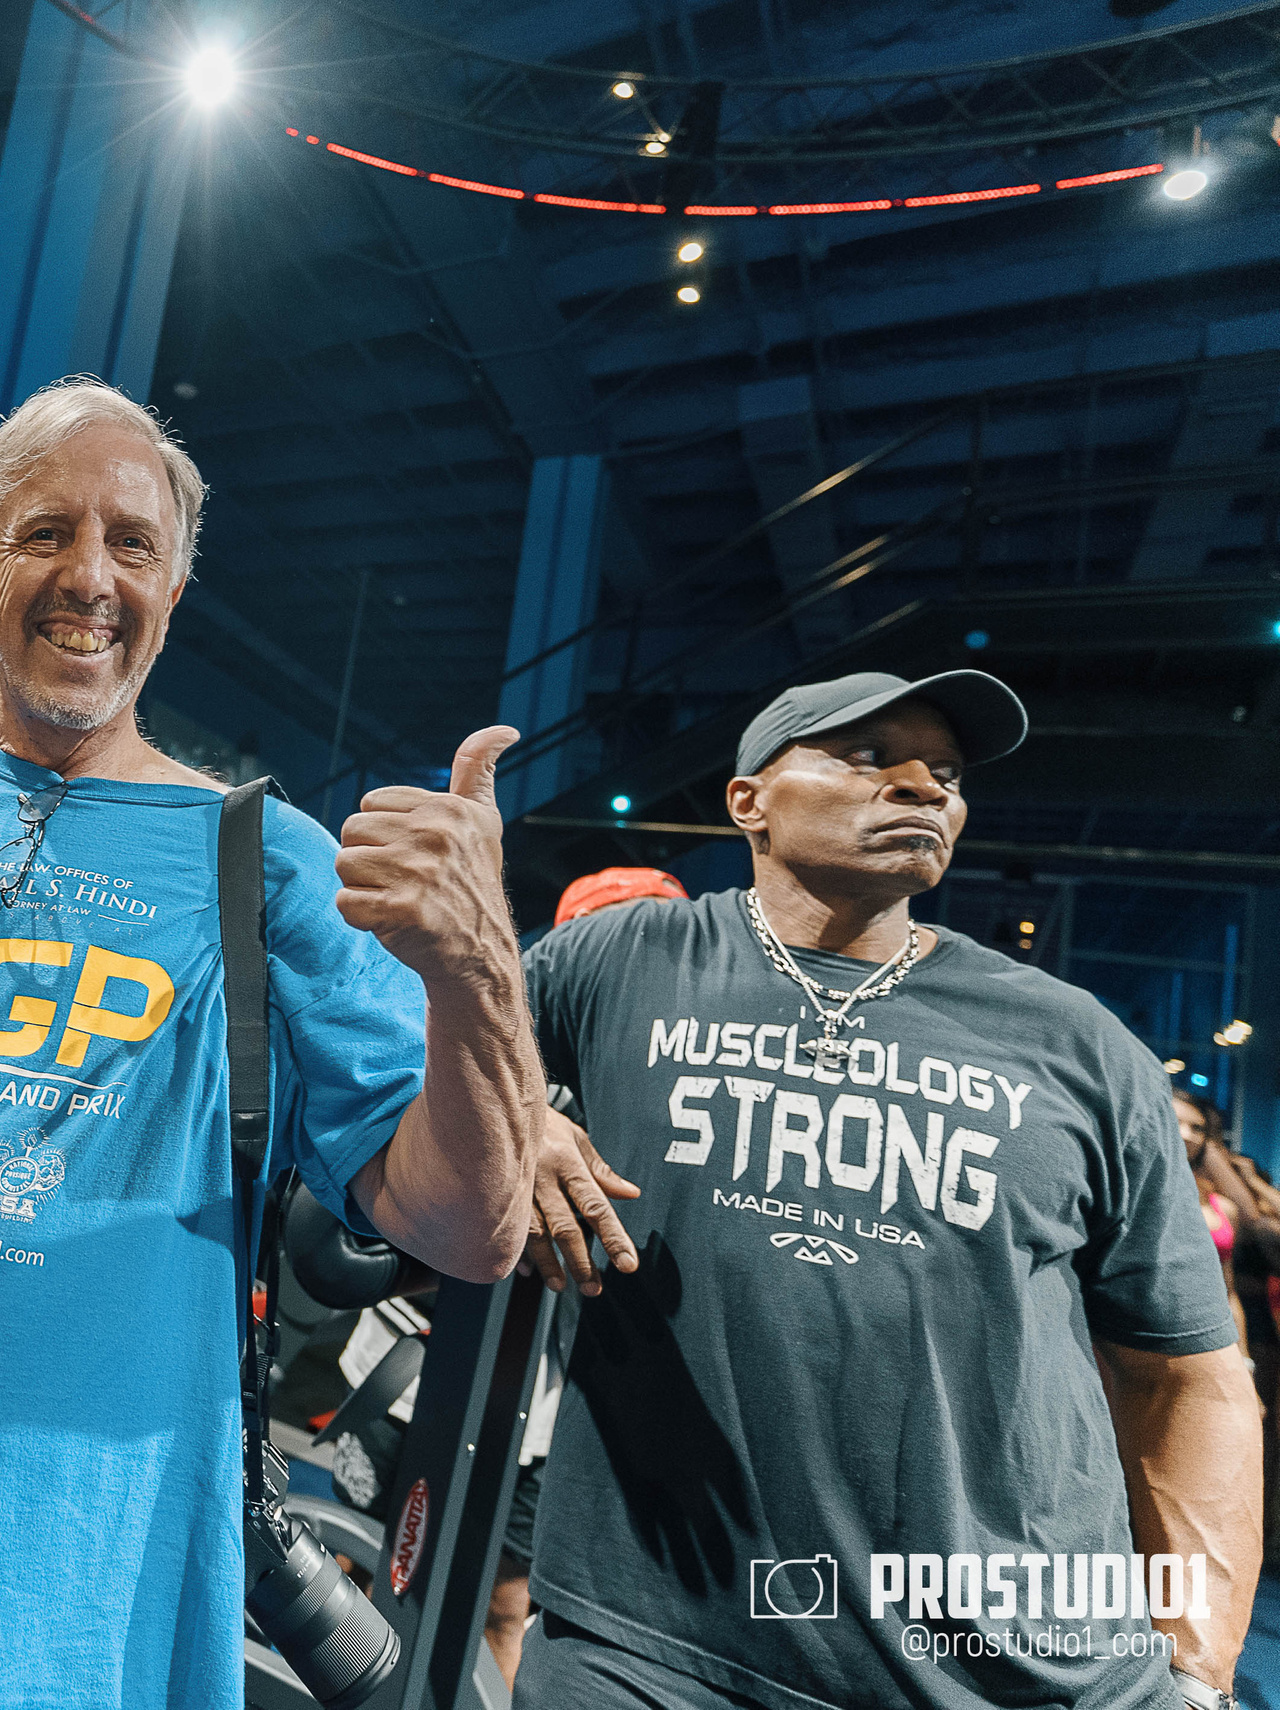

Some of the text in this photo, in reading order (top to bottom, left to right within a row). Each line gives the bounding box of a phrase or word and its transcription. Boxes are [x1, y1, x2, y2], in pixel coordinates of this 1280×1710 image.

[54, 865, 110, 886] OFFICES
[113, 878, 134, 890] OF
[45, 879, 65, 898] S.
[74, 884, 158, 919] HINDI
[50, 903, 66, 912] AT
[67, 906, 91, 916] LAW
[800, 1005, 807, 1019] I
[647, 1017, 1032, 1130] MUSCLEOLOGY
[67, 1093, 126, 1119] PRIX
[663, 1075, 1000, 1232] STRONG
[712, 1188, 926, 1250] MADE IN USA
